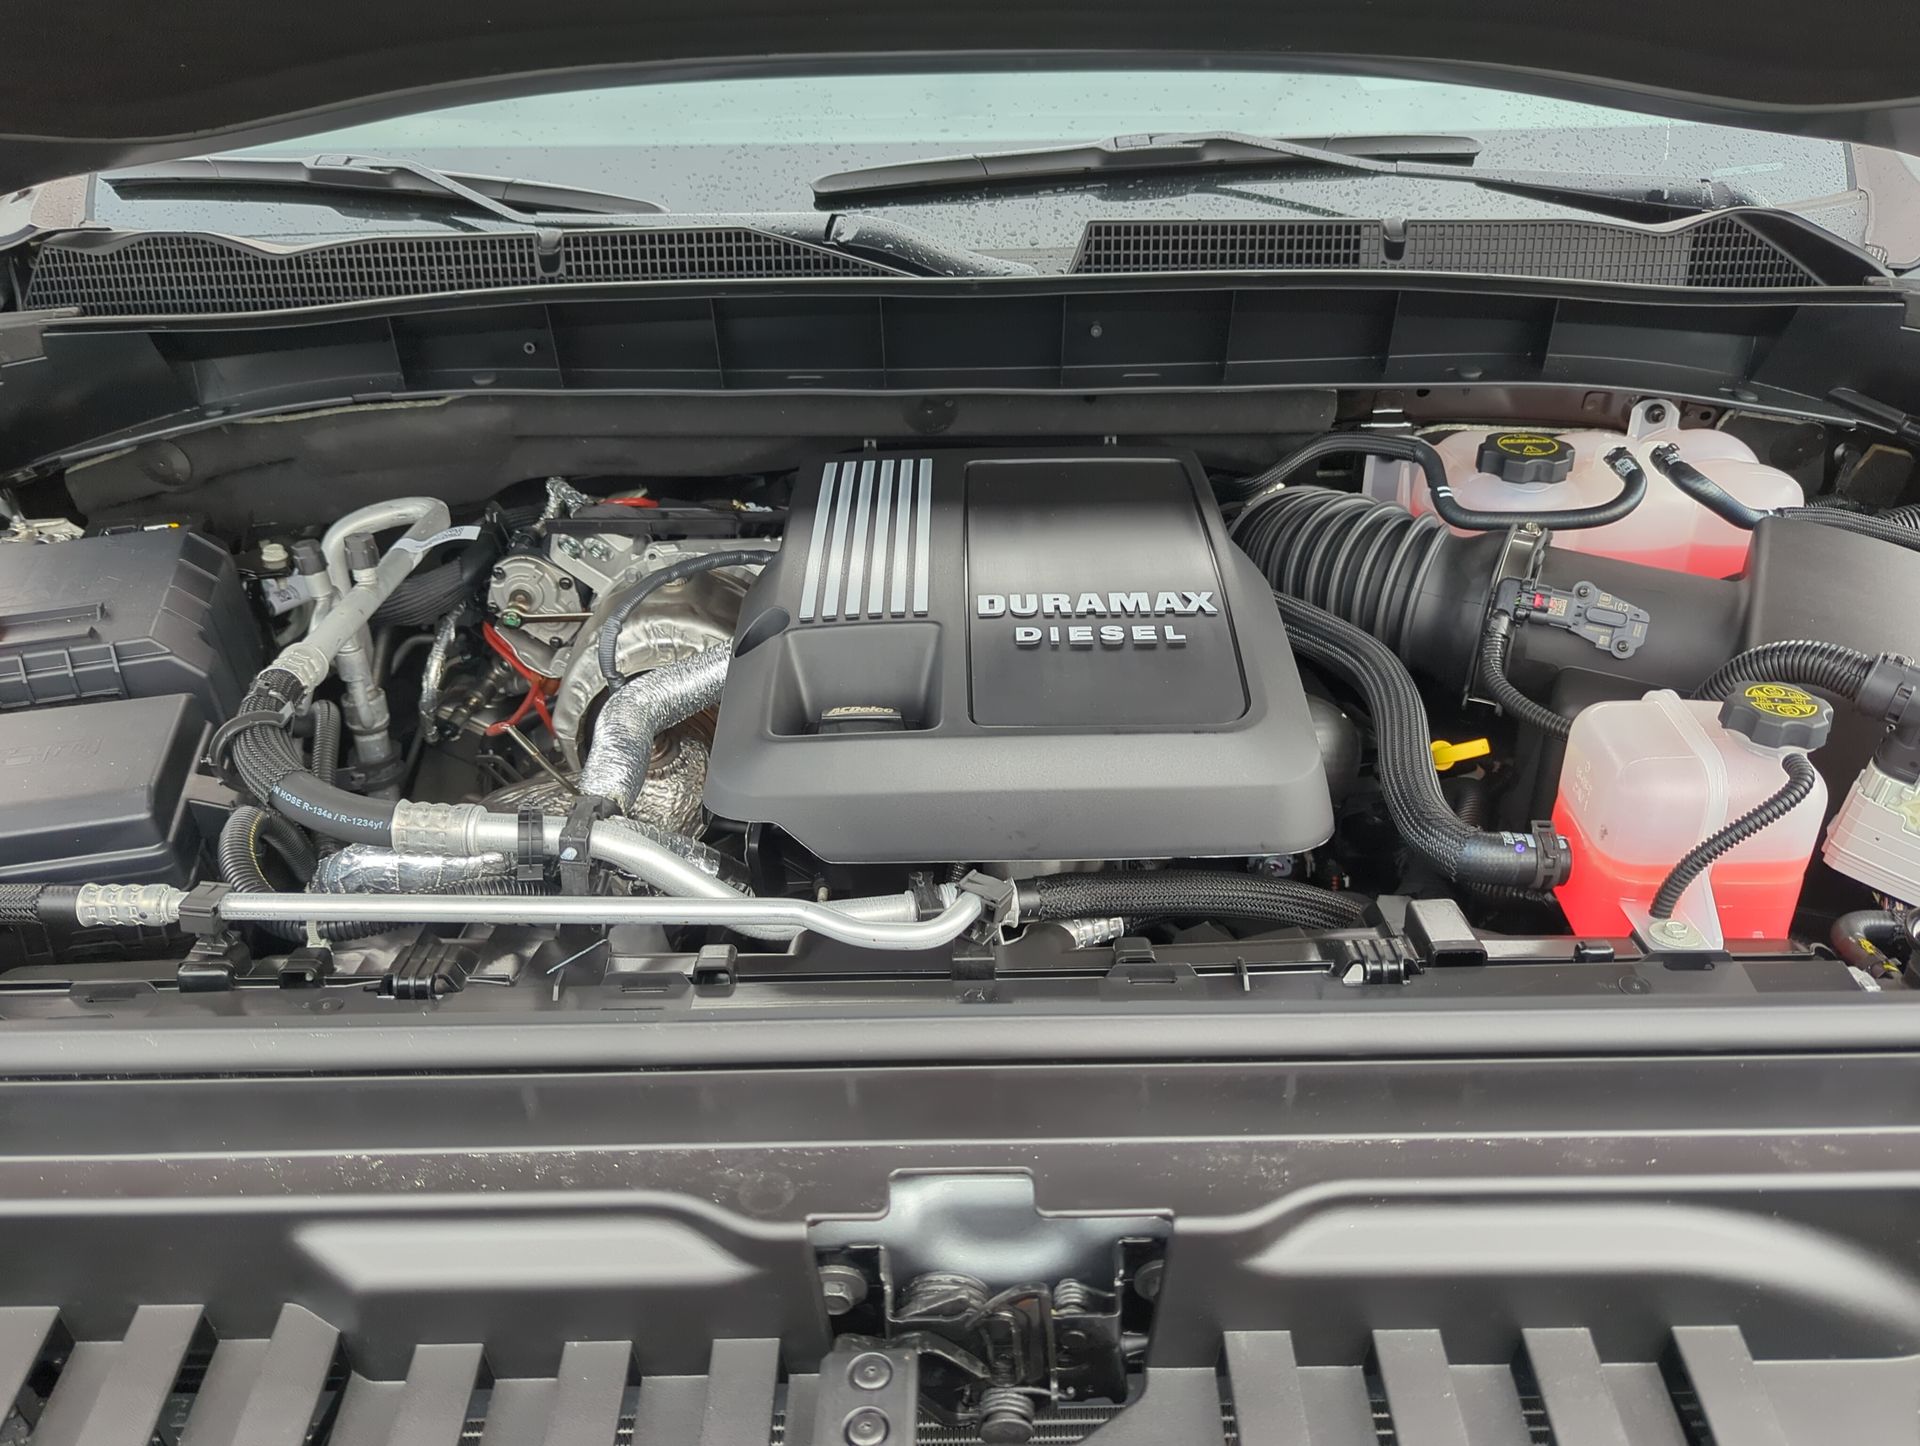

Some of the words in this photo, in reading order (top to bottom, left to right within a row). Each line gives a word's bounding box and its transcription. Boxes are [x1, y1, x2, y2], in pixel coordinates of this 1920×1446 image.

[977, 591, 1218, 617] DURAMAX
[1015, 625, 1187, 645] DIESEL
[826, 706, 894, 716] ACDelco
[280, 789, 302, 808] HOSE
[302, 802, 333, 820] R-134a
[339, 814, 384, 831] R-1234yf
